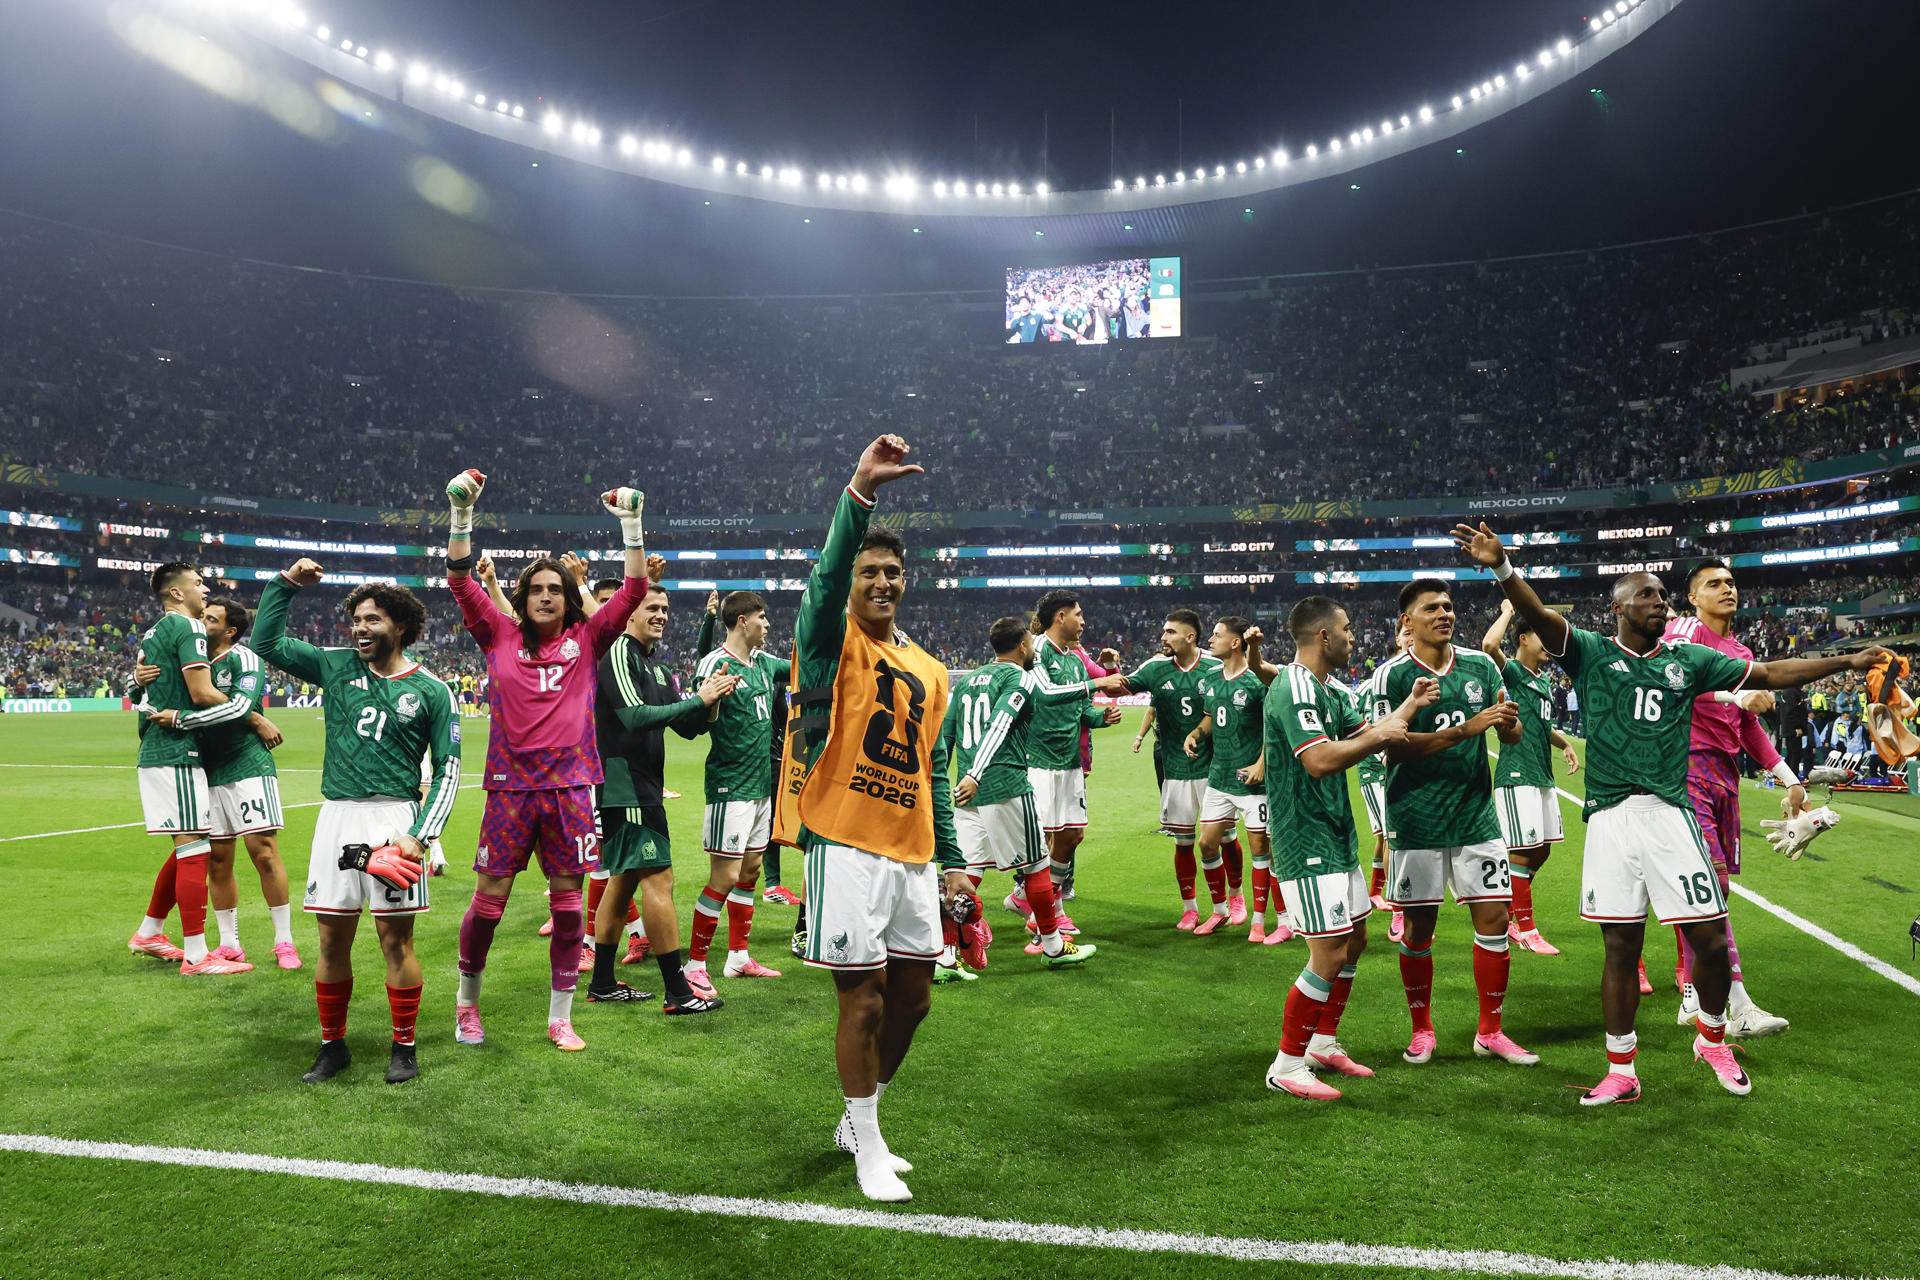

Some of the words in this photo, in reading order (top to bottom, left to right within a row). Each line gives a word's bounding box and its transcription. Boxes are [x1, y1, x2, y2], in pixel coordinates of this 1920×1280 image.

[1469, 498, 1528, 509] MEXICO
[1530, 496, 1566, 506] CITY
[143, 527, 169, 538] CITY
[723, 518, 753, 526] CITY
[1598, 528, 1643, 540] MEXICO
[1645, 526, 1672, 537] CITY
[526, 550, 551, 558] CITY
[1249, 542, 1274, 551] CITY
[98, 558, 142, 571] MEXICO
[1598, 563, 1643, 575] MEXICO
[1645, 561, 1672, 572] CITY
[1204, 575, 1247, 584] MEXICO
[1249, 574, 1274, 583] CITY
[536, 664, 563, 692] 12
[1, 699, 72, 713] ramco
[1181, 696, 1193, 716] 5
[1540, 698, 1551, 721] 18
[1634, 687, 1663, 721] 16
[357, 706, 387, 741] 21
[962, 692, 991, 749] 10
[1216, 706, 1227, 727] 8
[881, 742, 908, 764] FIFA
[856, 763, 897, 785] WORLD
[898, 778, 920, 791] CUP
[848, 775, 917, 809] 2026
[240, 798, 266, 824] 24
[1258, 803, 1268, 823] 8
[575, 832, 599, 864] 12
[1481, 859, 1510, 889] 23
[1678, 872, 1712, 905] 16
